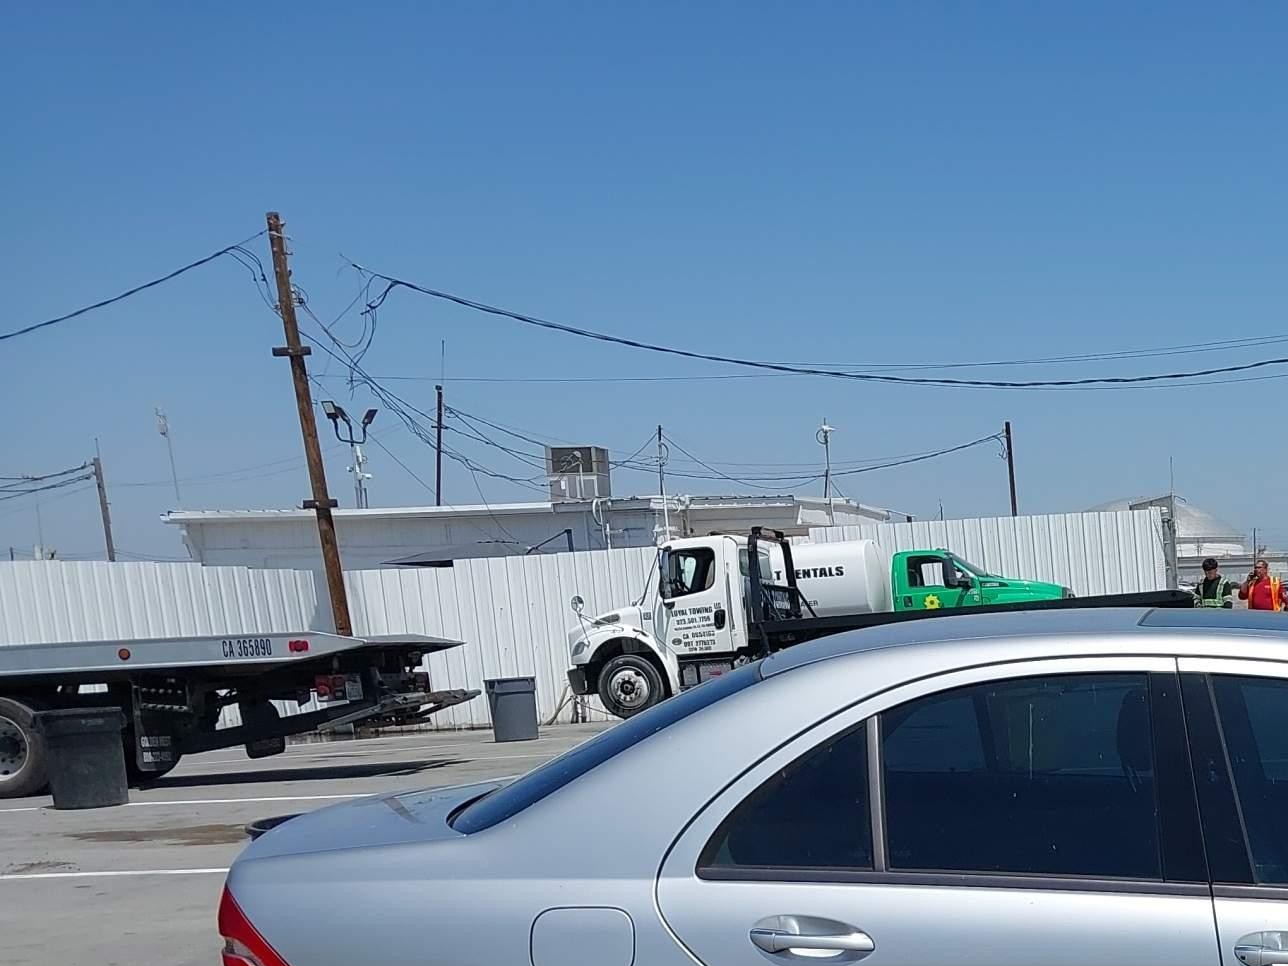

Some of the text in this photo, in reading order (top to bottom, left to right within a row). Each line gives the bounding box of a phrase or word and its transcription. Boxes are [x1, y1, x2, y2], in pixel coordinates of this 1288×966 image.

[795, 566, 844, 580] ENTALS
[671, 609, 688, 617] LOYAL
[688, 606, 713, 615] TOWING
[222, 638, 272, 658] CA 365890
